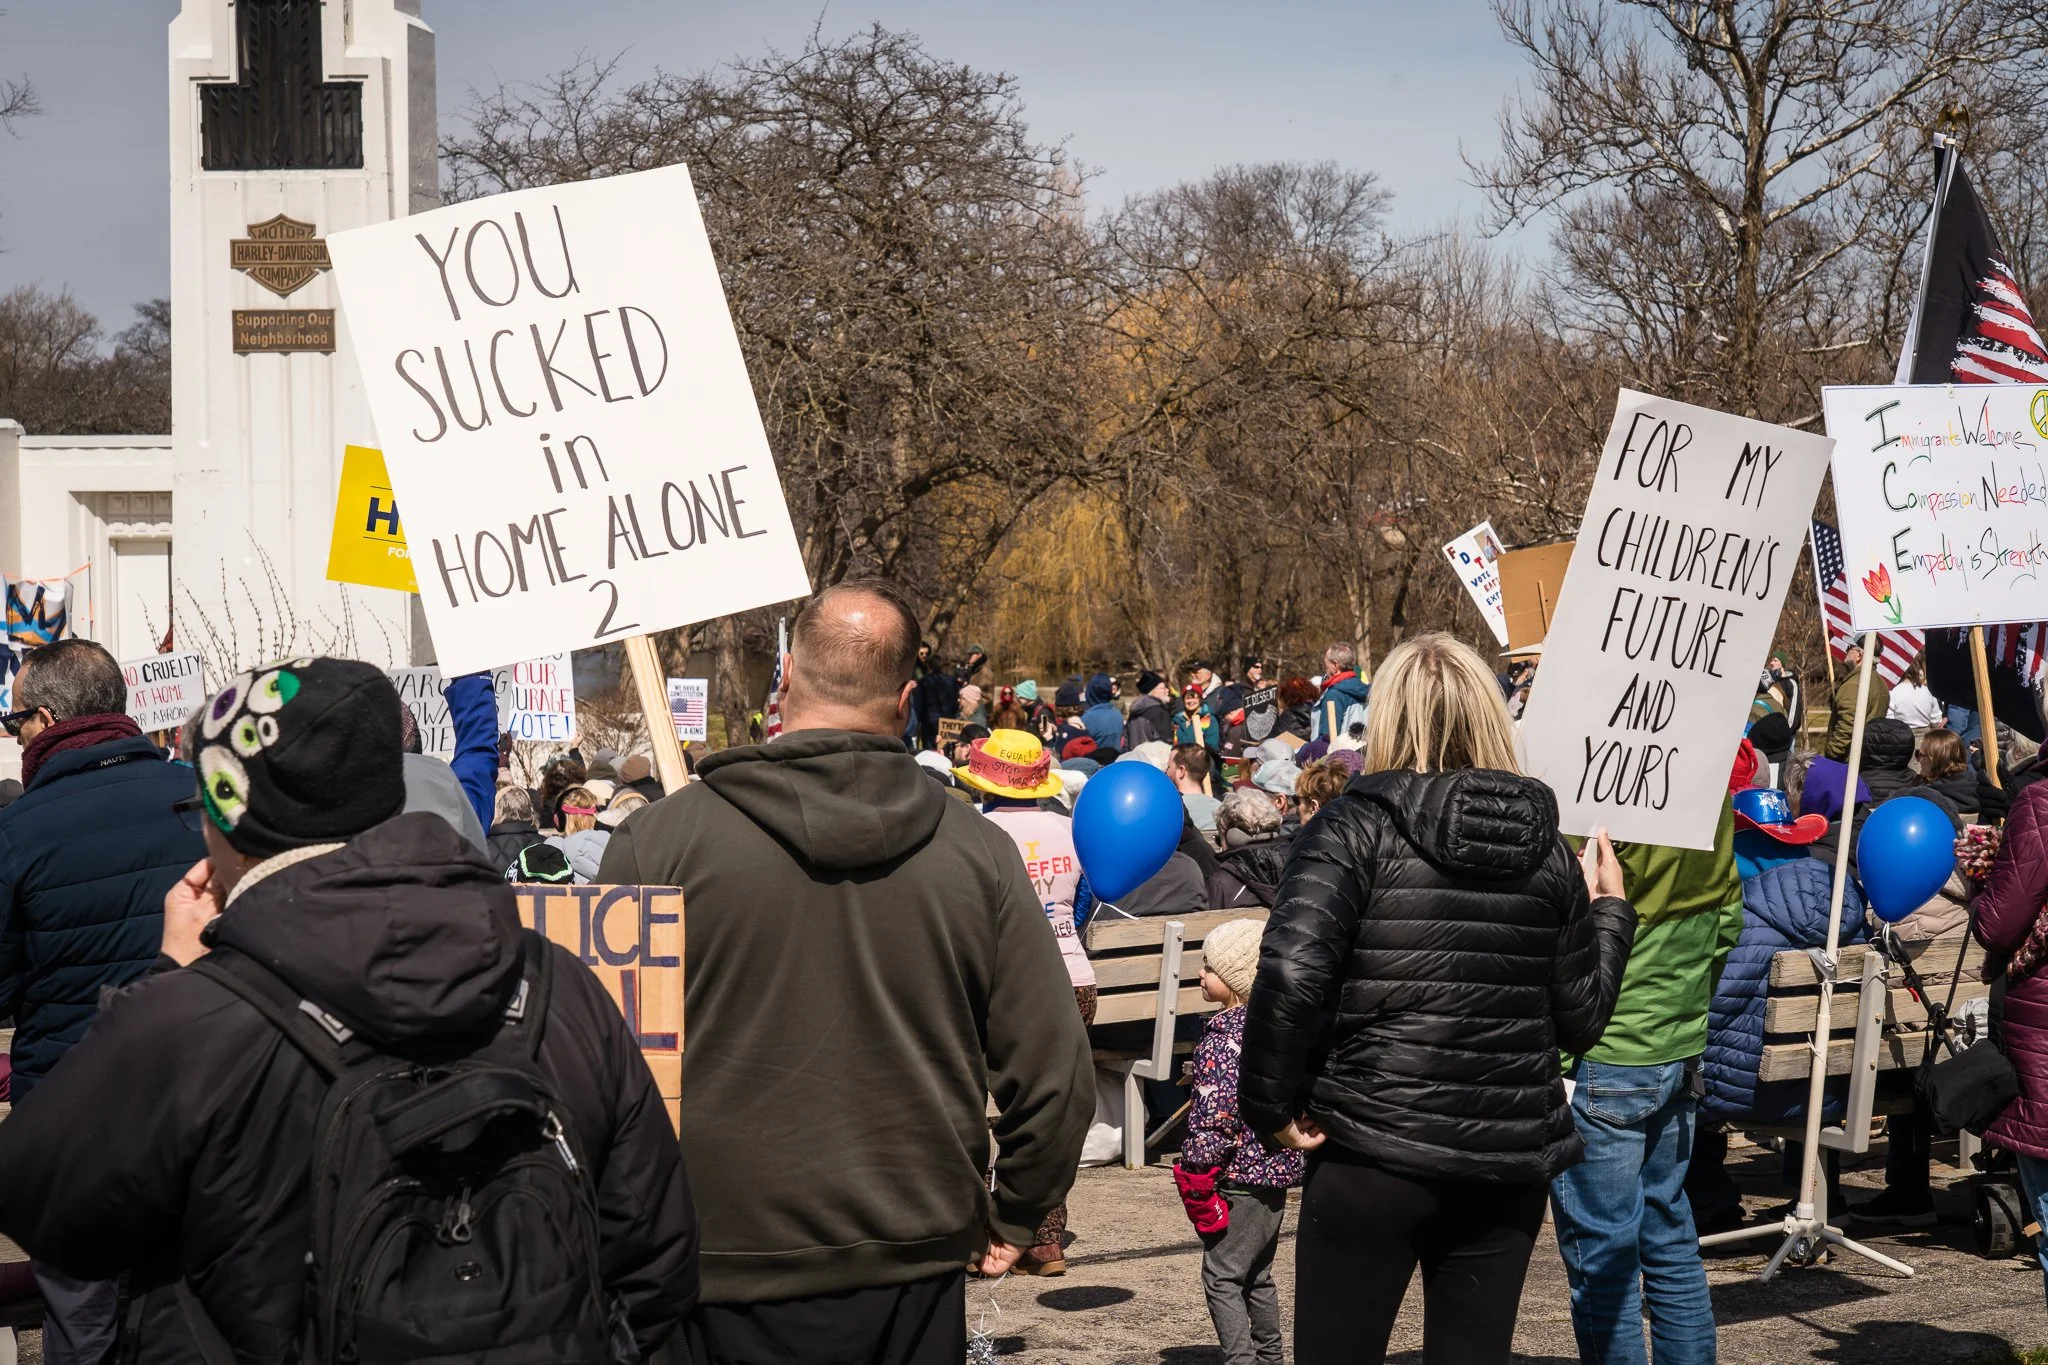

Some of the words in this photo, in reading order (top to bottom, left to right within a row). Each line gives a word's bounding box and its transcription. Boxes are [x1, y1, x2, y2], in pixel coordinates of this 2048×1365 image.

[258, 224, 305, 239] MOTOR
[237, 245, 328, 260] HARLEY-DAVIDSON
[414, 204, 580, 321] YOU
[259, 267, 306, 287] COMPANY
[236, 313, 305, 328] Supporting
[308, 313, 331, 325] Our
[240, 332, 328, 347] Neighborhood
[394, 306, 668, 443] SUCKED
[539, 432, 610, 494] in
[1613, 412, 1693, 493] FOR
[1725, 442, 1783, 512] MY
[1882, 461, 1982, 521] Compassion
[1982, 461, 2047, 512] Needed
[431, 507, 588, 608] HOME
[607, 464, 768, 570] ALONE
[1459, 551, 1471, 565] D
[1473, 556, 1485, 569] T
[1597, 507, 1781, 601] CHILDREN'S
[1891, 526, 1969, 592] Empathy
[1966, 544, 1982, 569] is
[1979, 527, 2048, 590] Strength
[588, 579, 641, 639] 2
[1600, 587, 1744, 679] FUTURE
[124, 666, 139, 687] NO
[142, 654, 200, 683] CRUELTY
[514, 662, 558, 688] OUR
[135, 689, 147, 708] AT
[151, 684, 185, 705] HOME
[1245, 696, 1251, 709] I
[1252, 687, 1277, 705] DISSENT
[1607, 672, 1676, 734] AND
[153, 706, 190, 725] ABROAD
[690, 727, 704, 735] KING
[1575, 735, 1679, 811] YOURS
[1025, 841, 1041, 861] I
[1027, 856, 1072, 879] EFER
